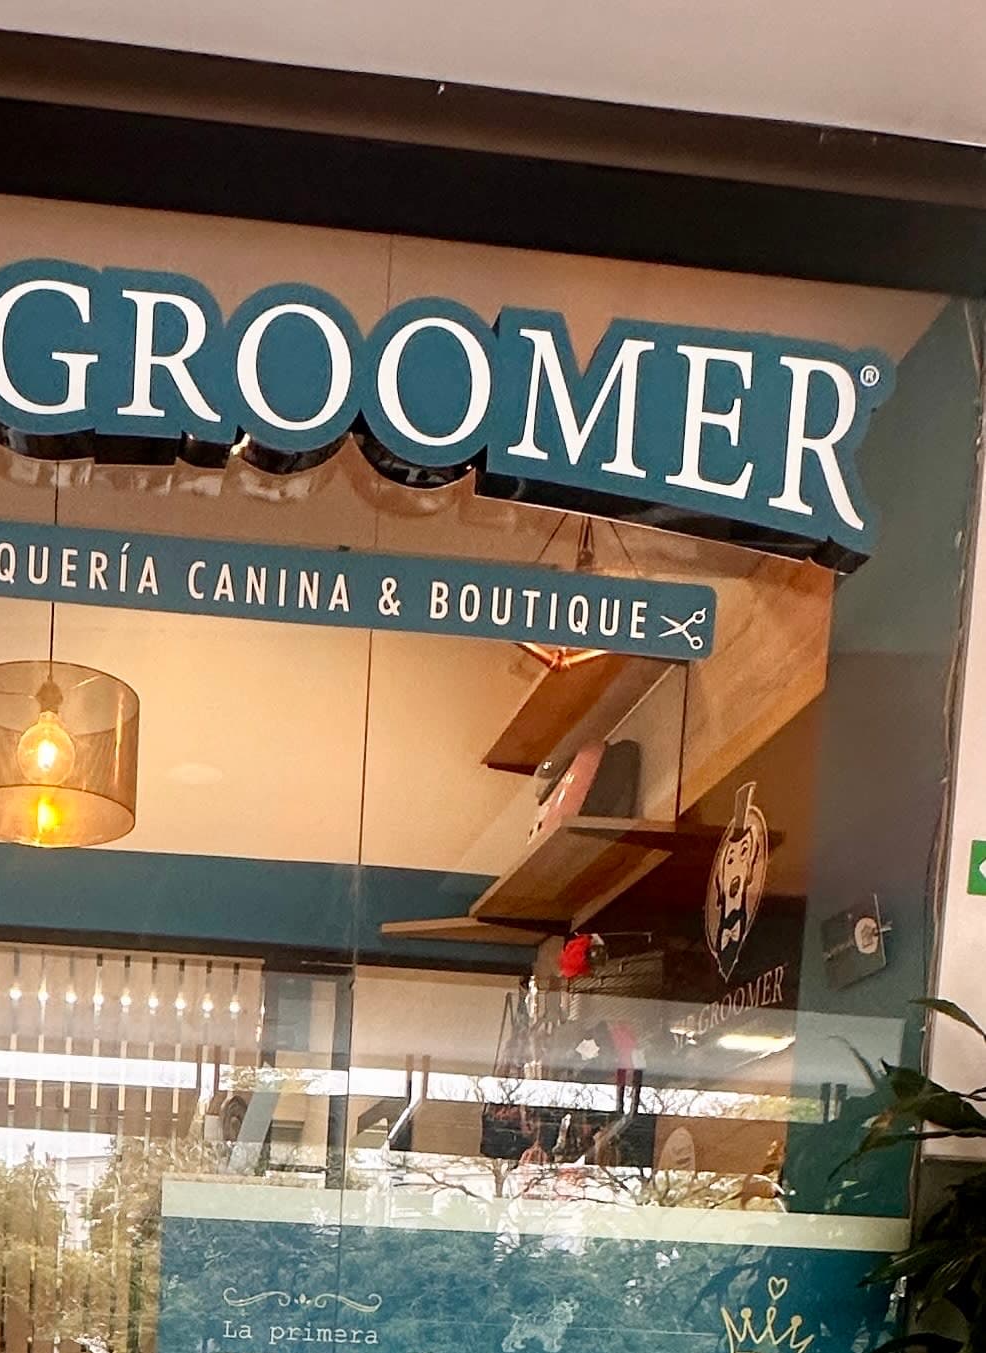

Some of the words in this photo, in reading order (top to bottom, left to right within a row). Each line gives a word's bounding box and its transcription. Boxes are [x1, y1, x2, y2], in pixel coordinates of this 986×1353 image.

[186, 560, 350, 613] CANINA
[378, 576, 401, 617] &
[429, 580, 649, 640] BOUTIQUE
[696, 965, 784, 1035] GROOMER
[223, 1320, 253, 1340] La
[268, 1321, 379, 1345] primera
